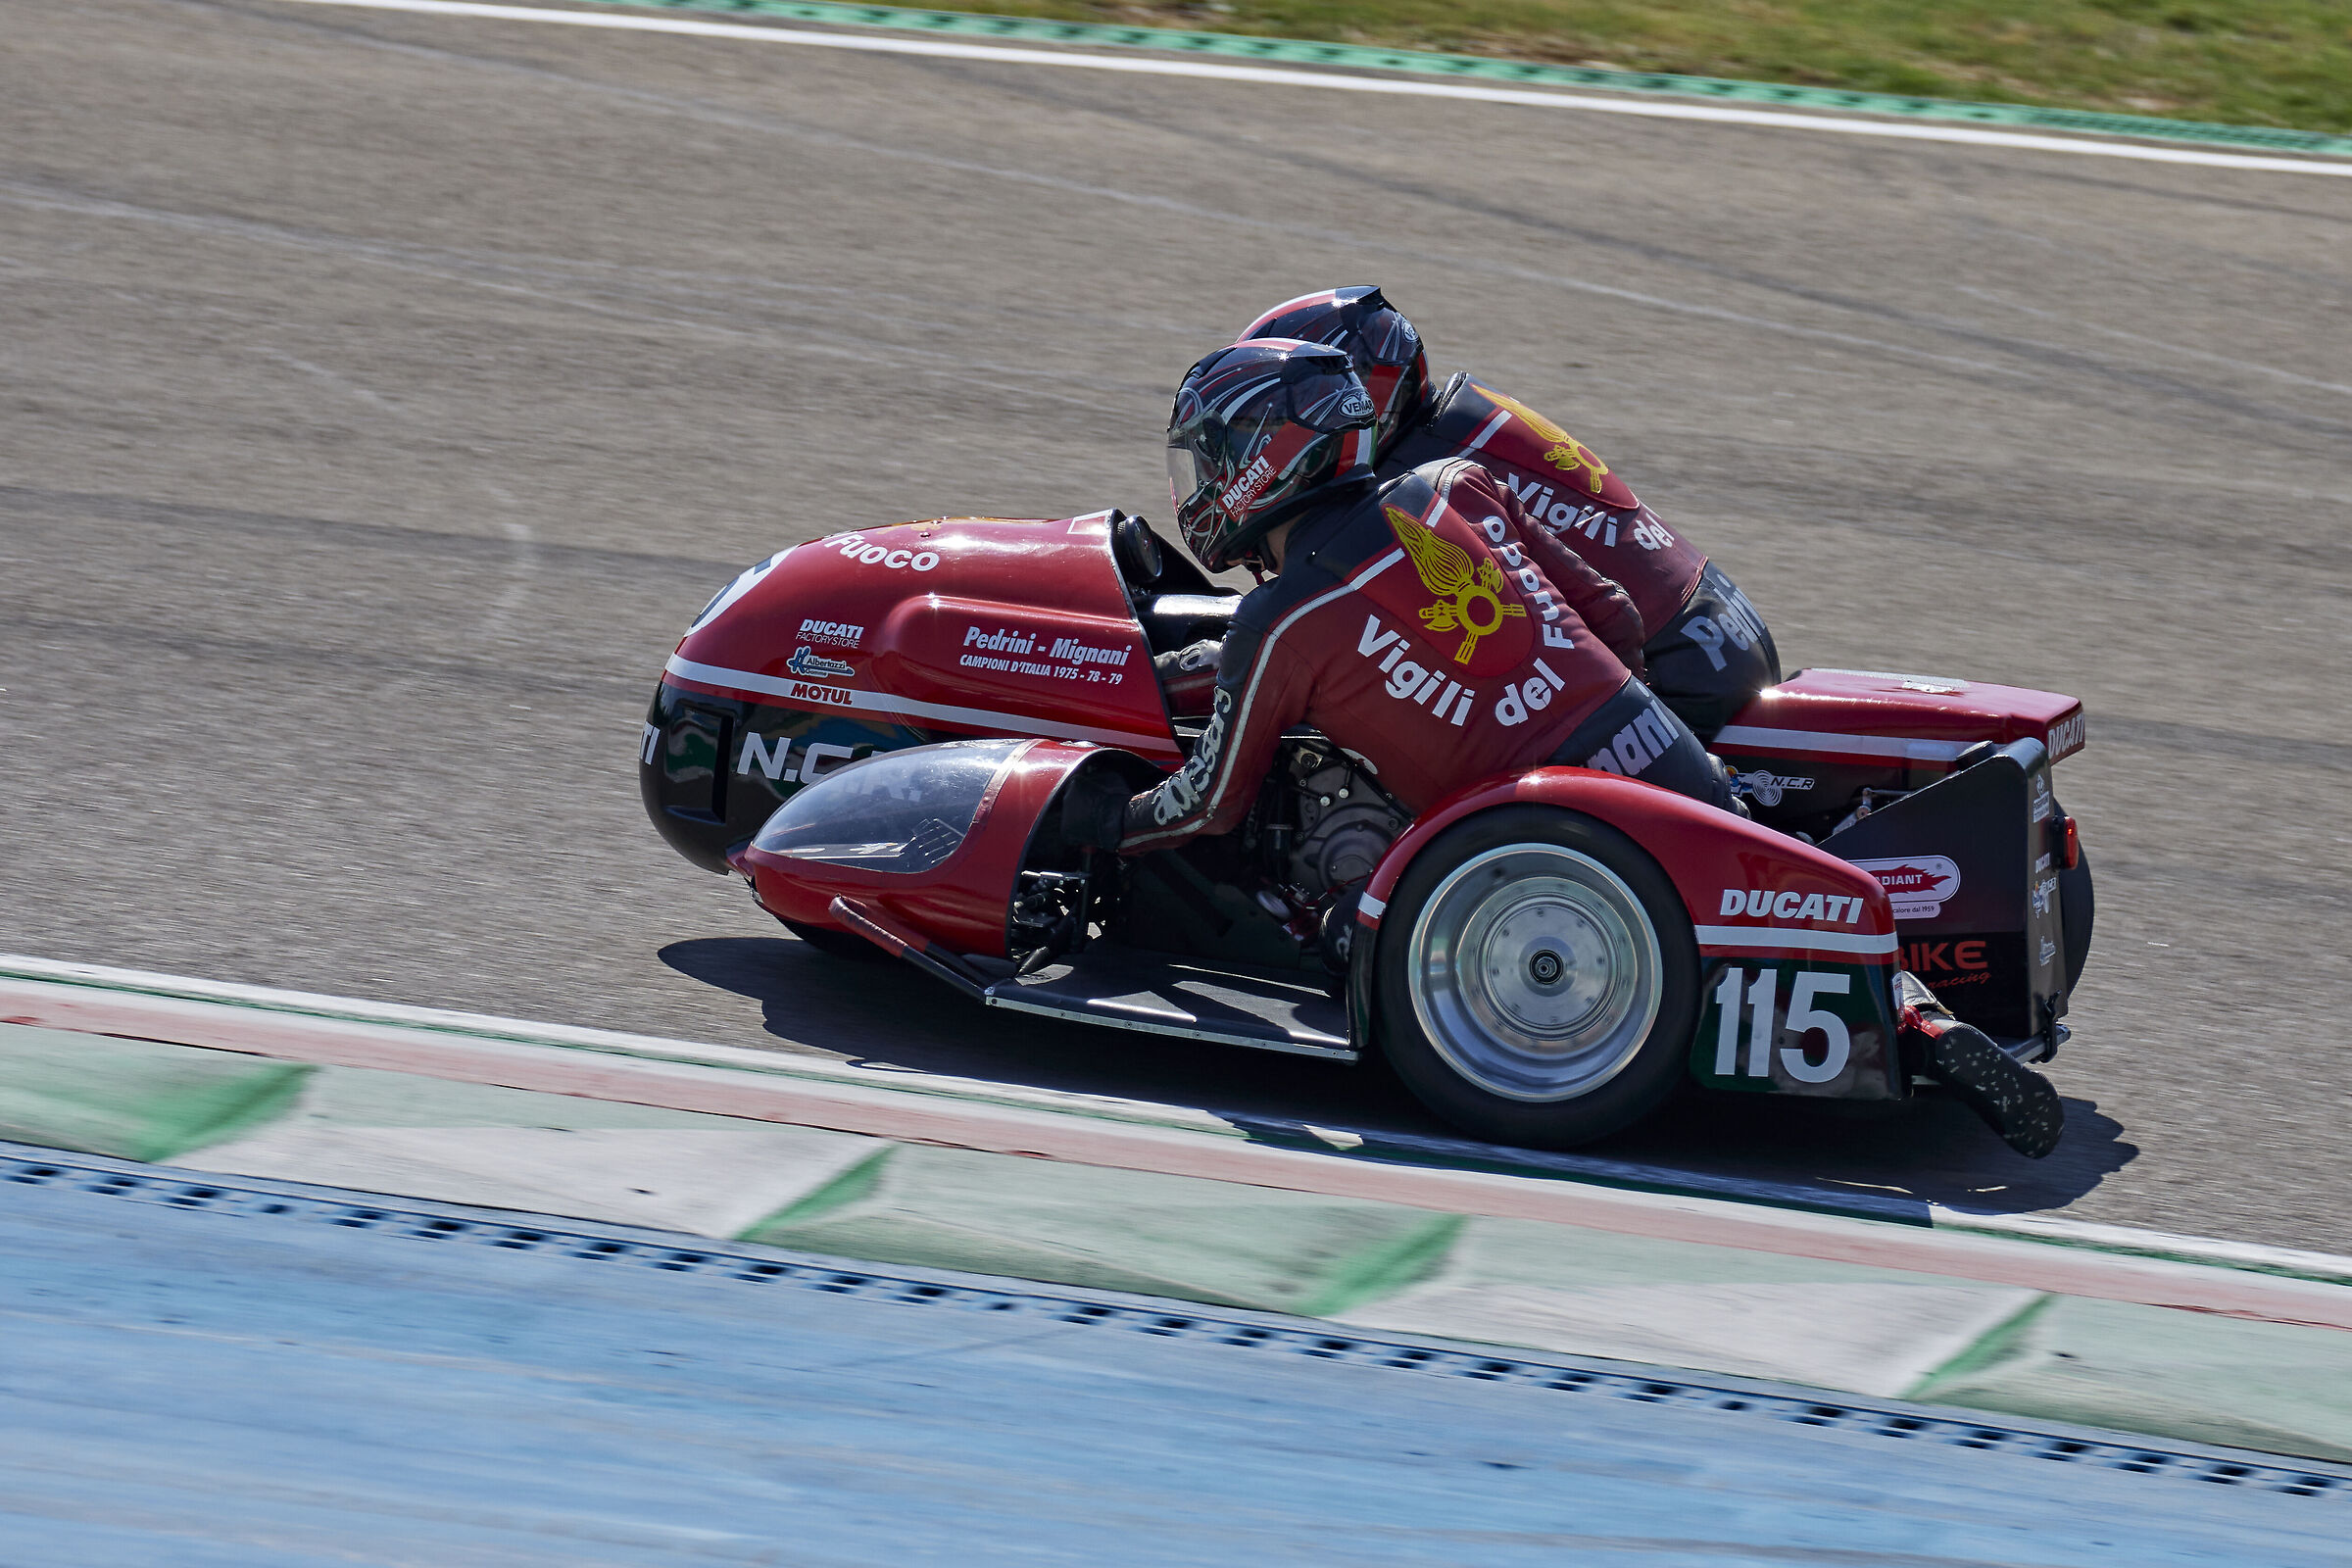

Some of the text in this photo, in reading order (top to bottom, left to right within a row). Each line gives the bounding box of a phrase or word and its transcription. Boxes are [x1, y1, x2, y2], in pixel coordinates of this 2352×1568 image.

[1222, 455, 1270, 510] DUCATI
[1230, 466, 1277, 517] FACTORY STORE
[1507, 472, 1675, 551] Vigili del
[824, 534, 940, 571] Fuoco
[800, 618, 864, 640] DUCATI
[1357, 514, 1575, 727] Vigili del Fuoco
[796, 631, 860, 650] FACTORY STORE
[962, 625, 1037, 655] Pedrini
[1049, 637, 1133, 666] Mignani
[807, 657, 847, 669] Albertazzi
[959, 654, 1010, 672] CAMPIONI
[1009, 660, 1052, 677] D'ITALIA
[1053, 665, 1079, 680] 1975
[1086, 670, 1102, 683] 78
[1107, 672, 1123, 685] 79
[790, 682, 853, 705] MOTUL
[2047, 712, 2085, 759] DUCATI
[1770, 776, 1814, 789] N.C.R
[1876, 874, 1923, 887] DIANT
[1720, 889, 1864, 924] DUCATI
[1922, 905, 1936, 913] 1959
[1715, 967, 1851, 1084] 115
